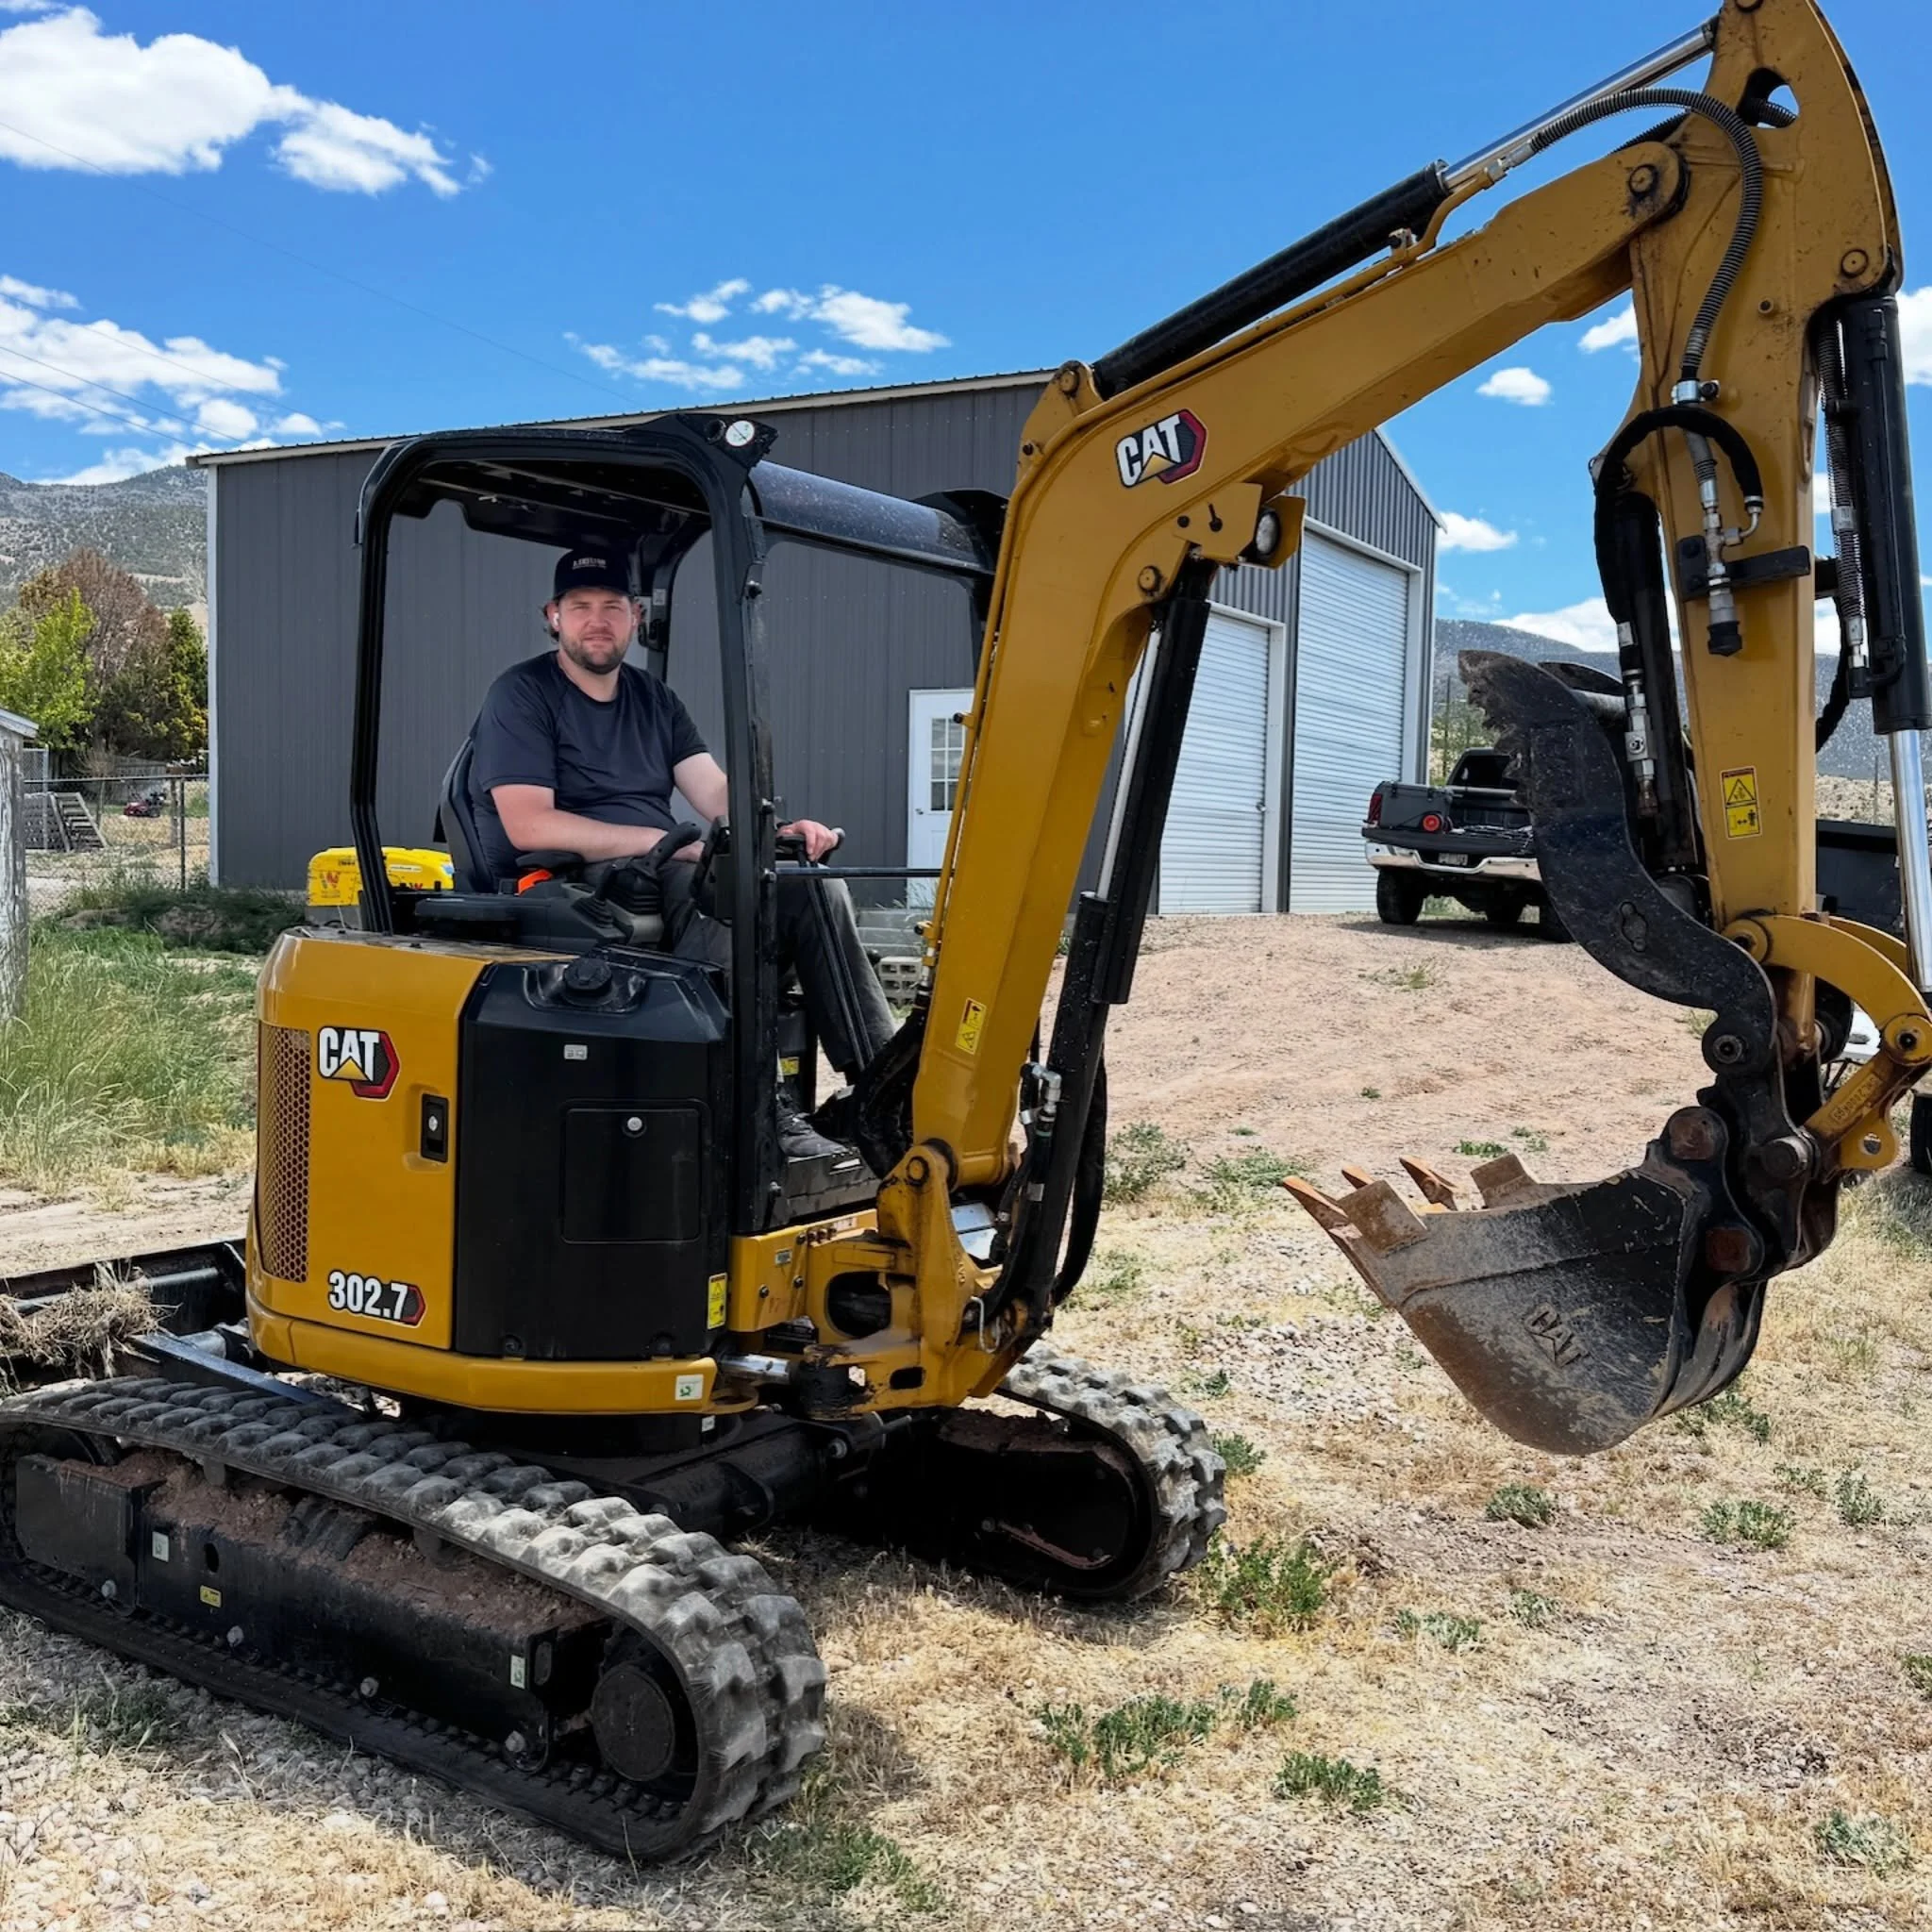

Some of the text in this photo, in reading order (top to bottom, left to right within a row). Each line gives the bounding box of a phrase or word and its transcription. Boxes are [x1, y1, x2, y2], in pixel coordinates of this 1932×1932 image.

[1116, 414, 1181, 487] CAT
[319, 1026, 379, 1082] CAT
[328, 1271, 408, 1321] 302.7
[1524, 1303, 1591, 1368] CAT
